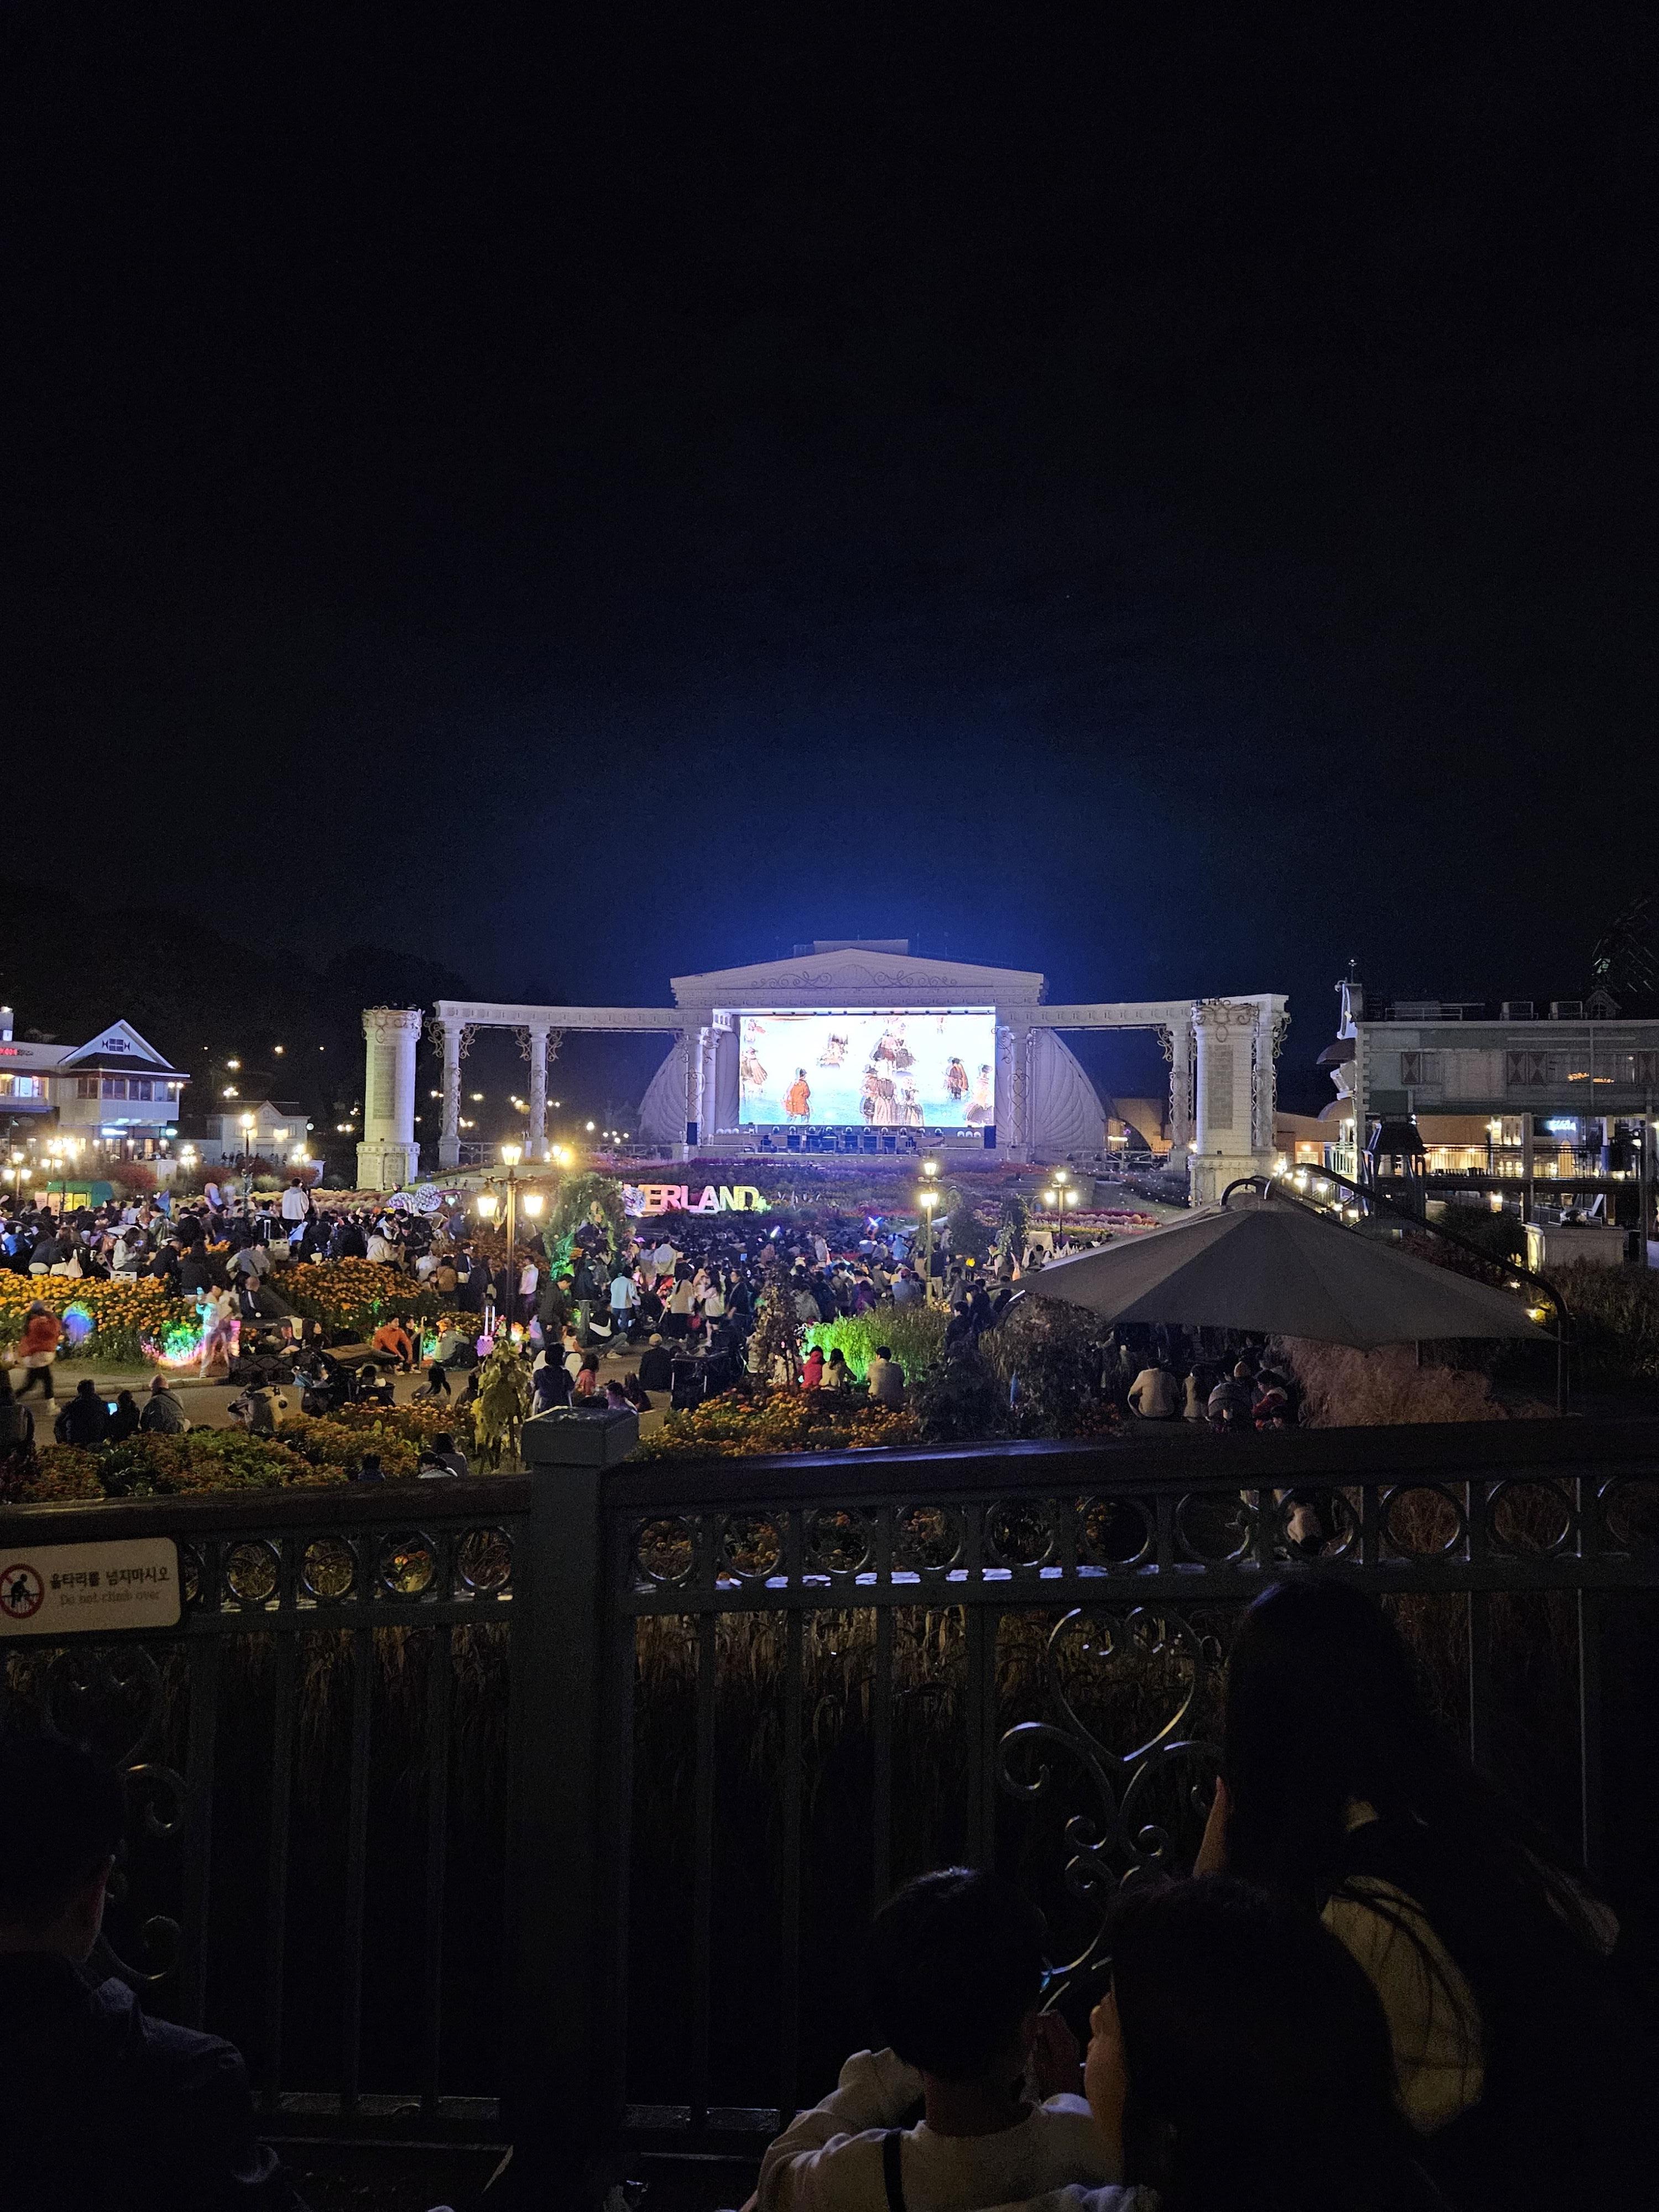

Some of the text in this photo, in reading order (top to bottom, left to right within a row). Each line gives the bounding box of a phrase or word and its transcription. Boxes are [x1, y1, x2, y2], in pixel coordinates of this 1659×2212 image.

[623, 1184, 760, 1214] ERLAND
[50, 1567, 170, 1589] 울타리를 넘지마시오
